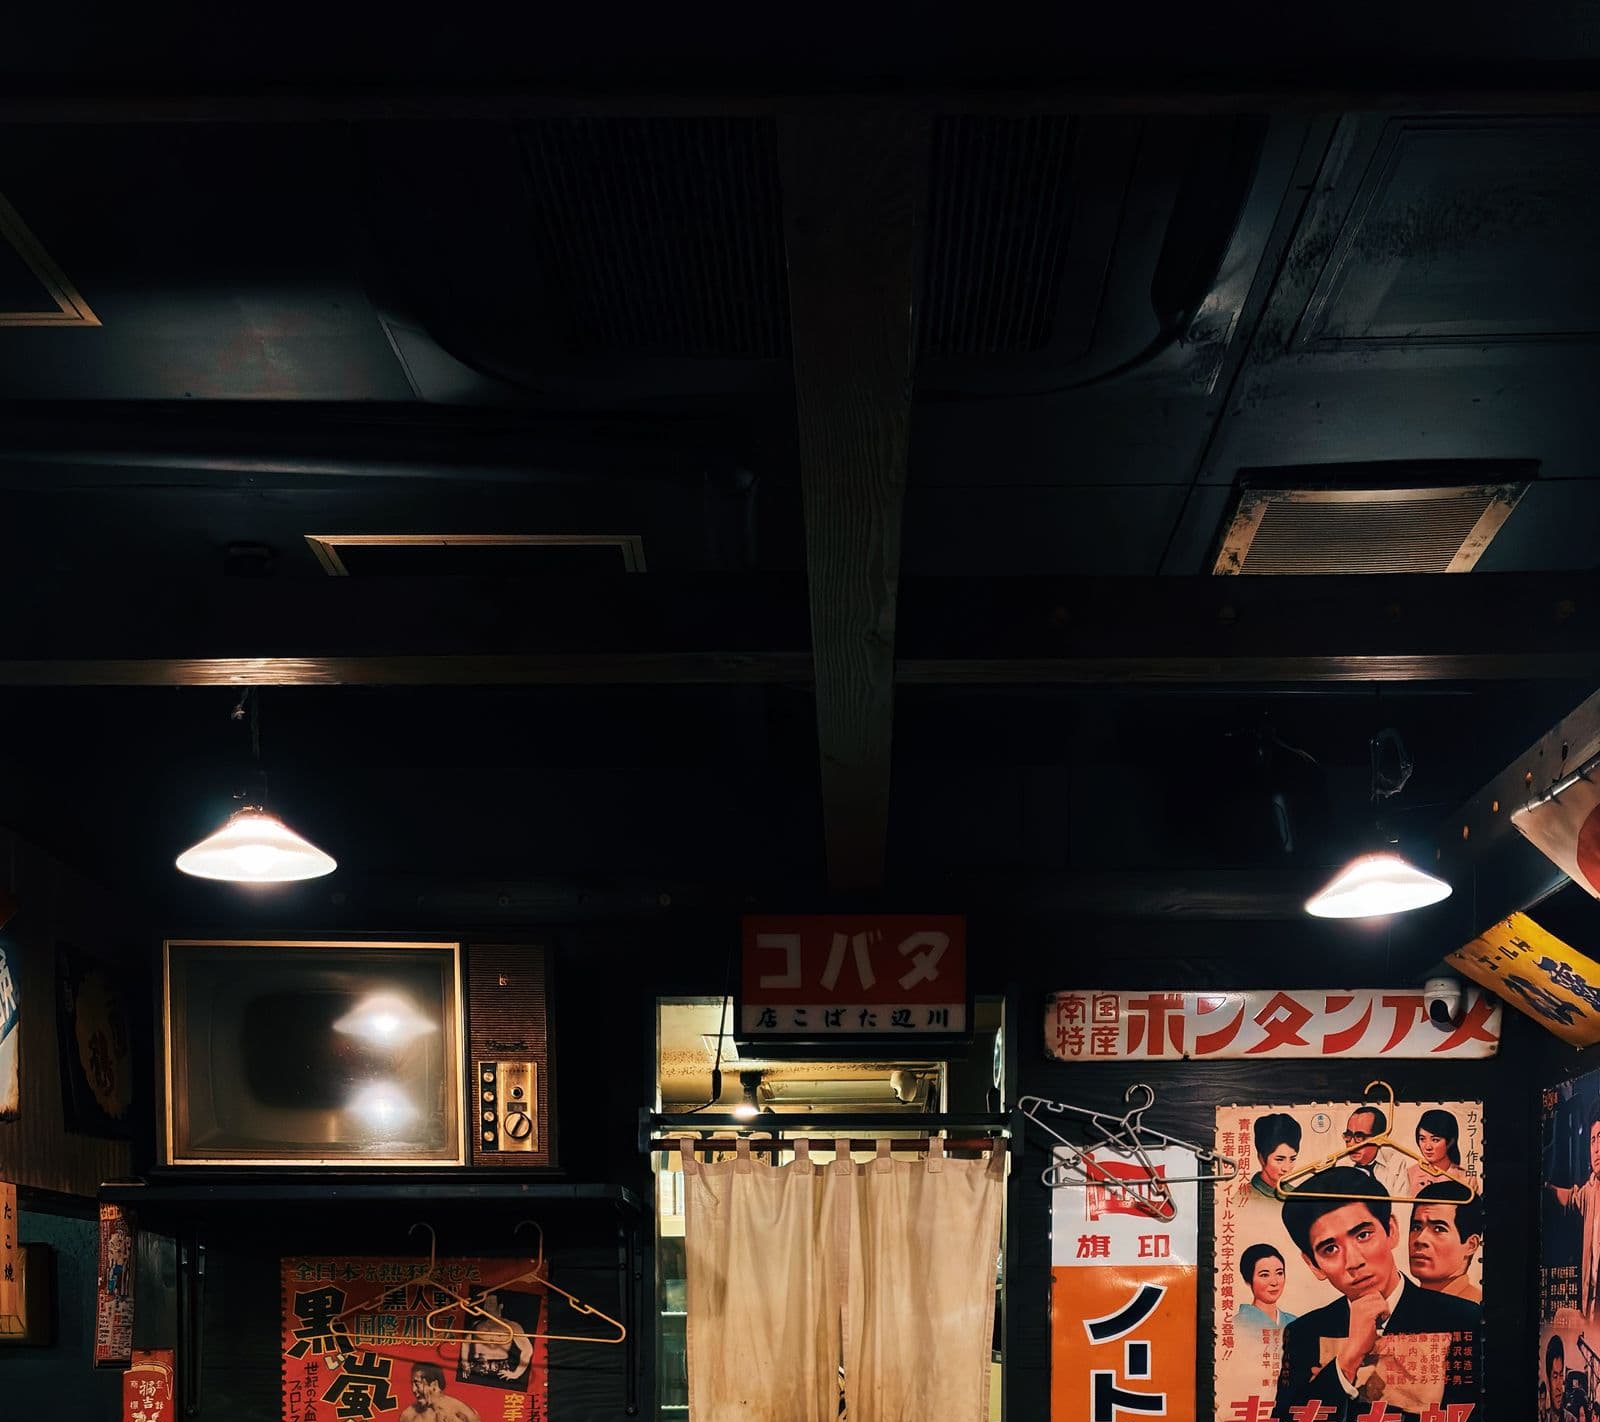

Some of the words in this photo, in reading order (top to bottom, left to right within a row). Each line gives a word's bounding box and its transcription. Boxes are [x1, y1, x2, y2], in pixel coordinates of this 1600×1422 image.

[1465, 1110, 1478, 1178] カラー作品
